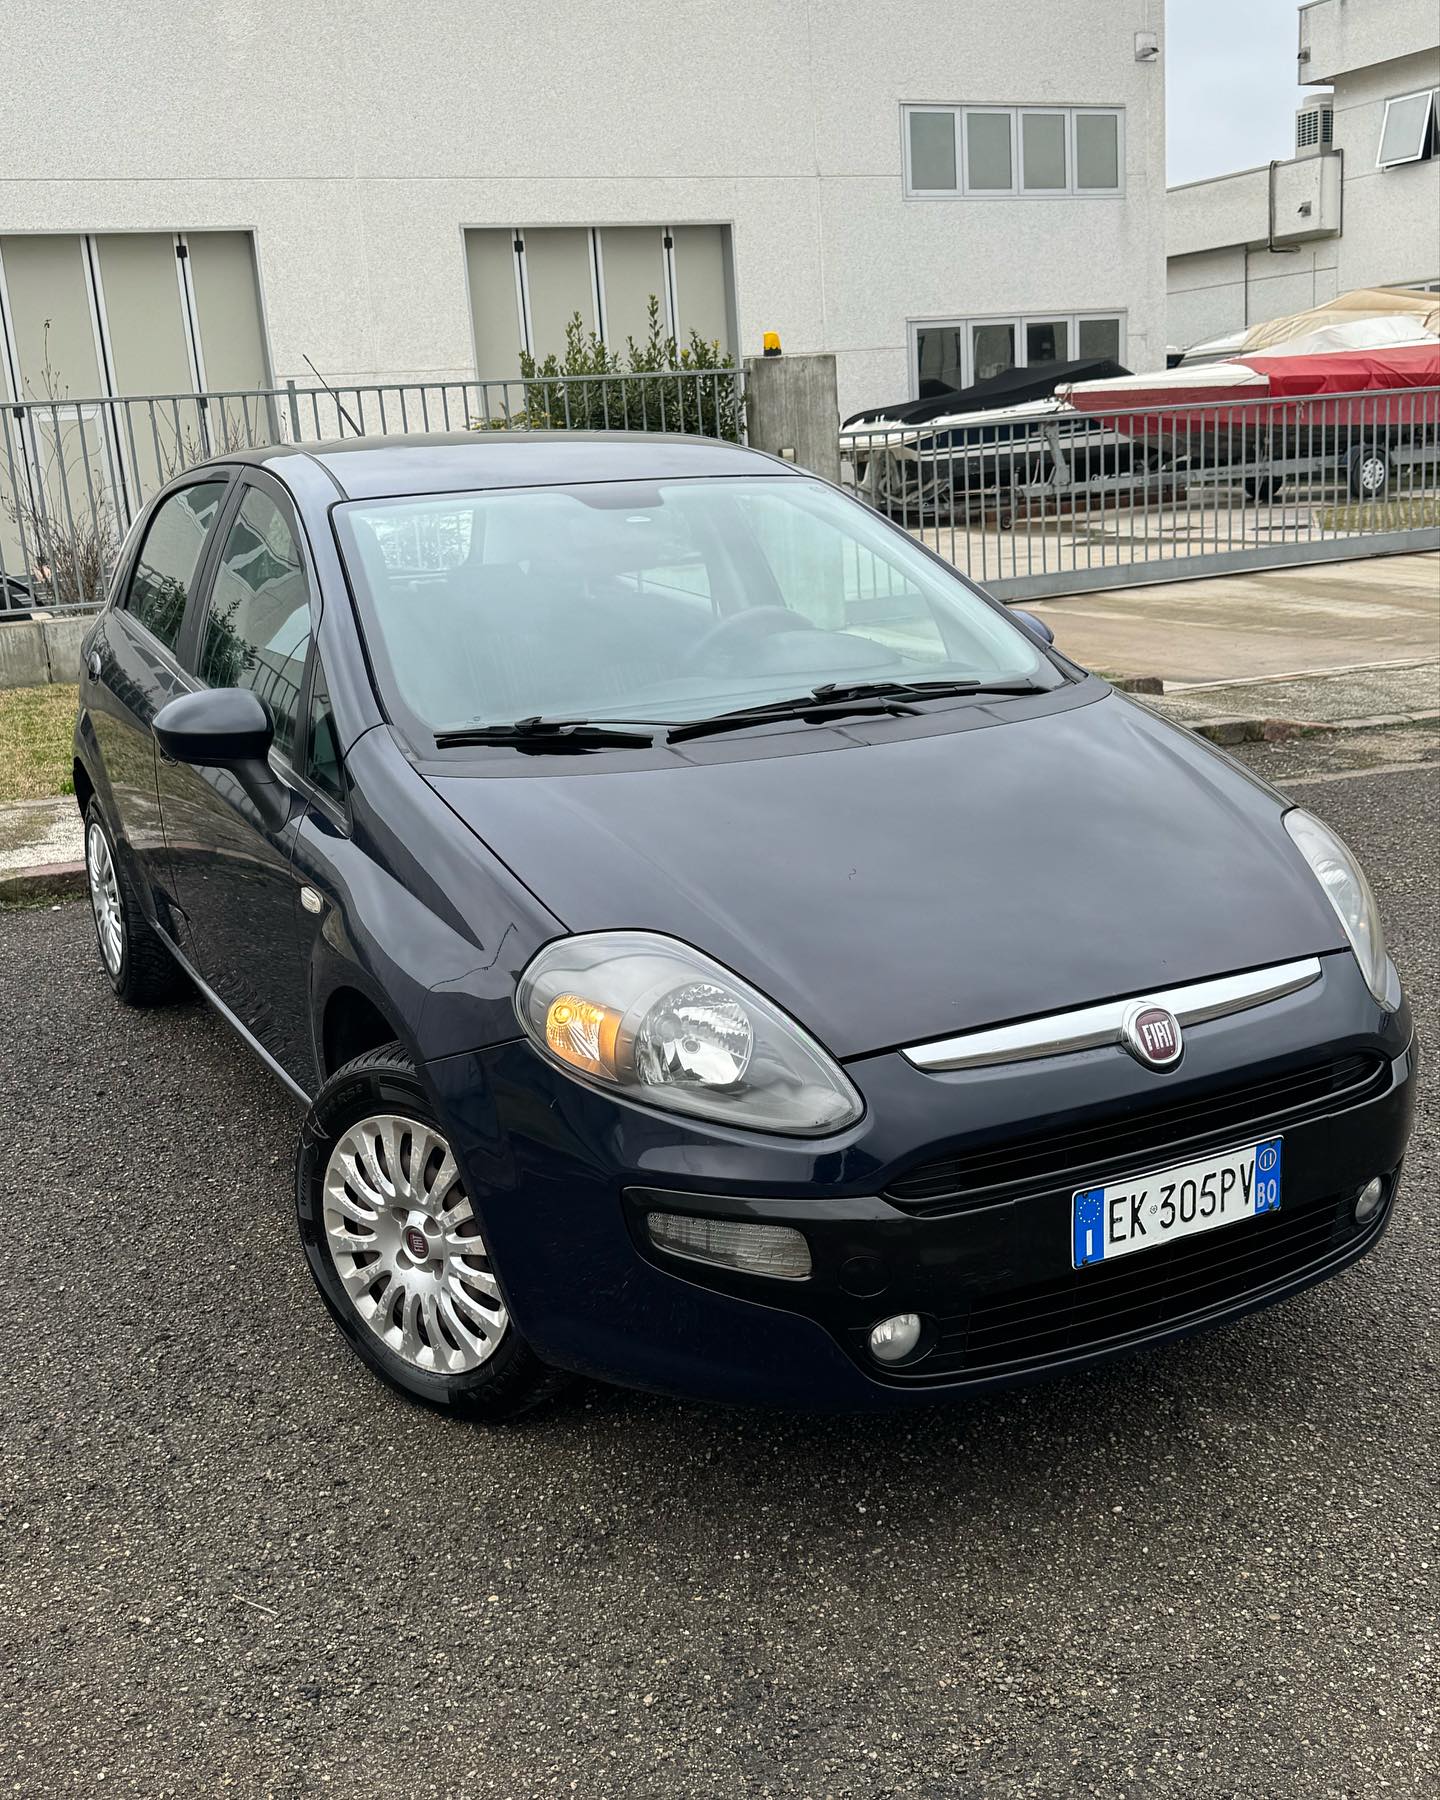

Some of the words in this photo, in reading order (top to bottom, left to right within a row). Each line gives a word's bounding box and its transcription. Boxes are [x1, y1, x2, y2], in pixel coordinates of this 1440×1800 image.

[1142, 1020, 1174, 1051] FIAT
[1108, 1190, 1148, 1244] EK
[1159, 1159, 1255, 1229] 305PV
[1257, 1178, 1277, 1208] BO
[412, 1233, 425, 1253] FIAT
[1086, 1229, 1093, 1256] I
